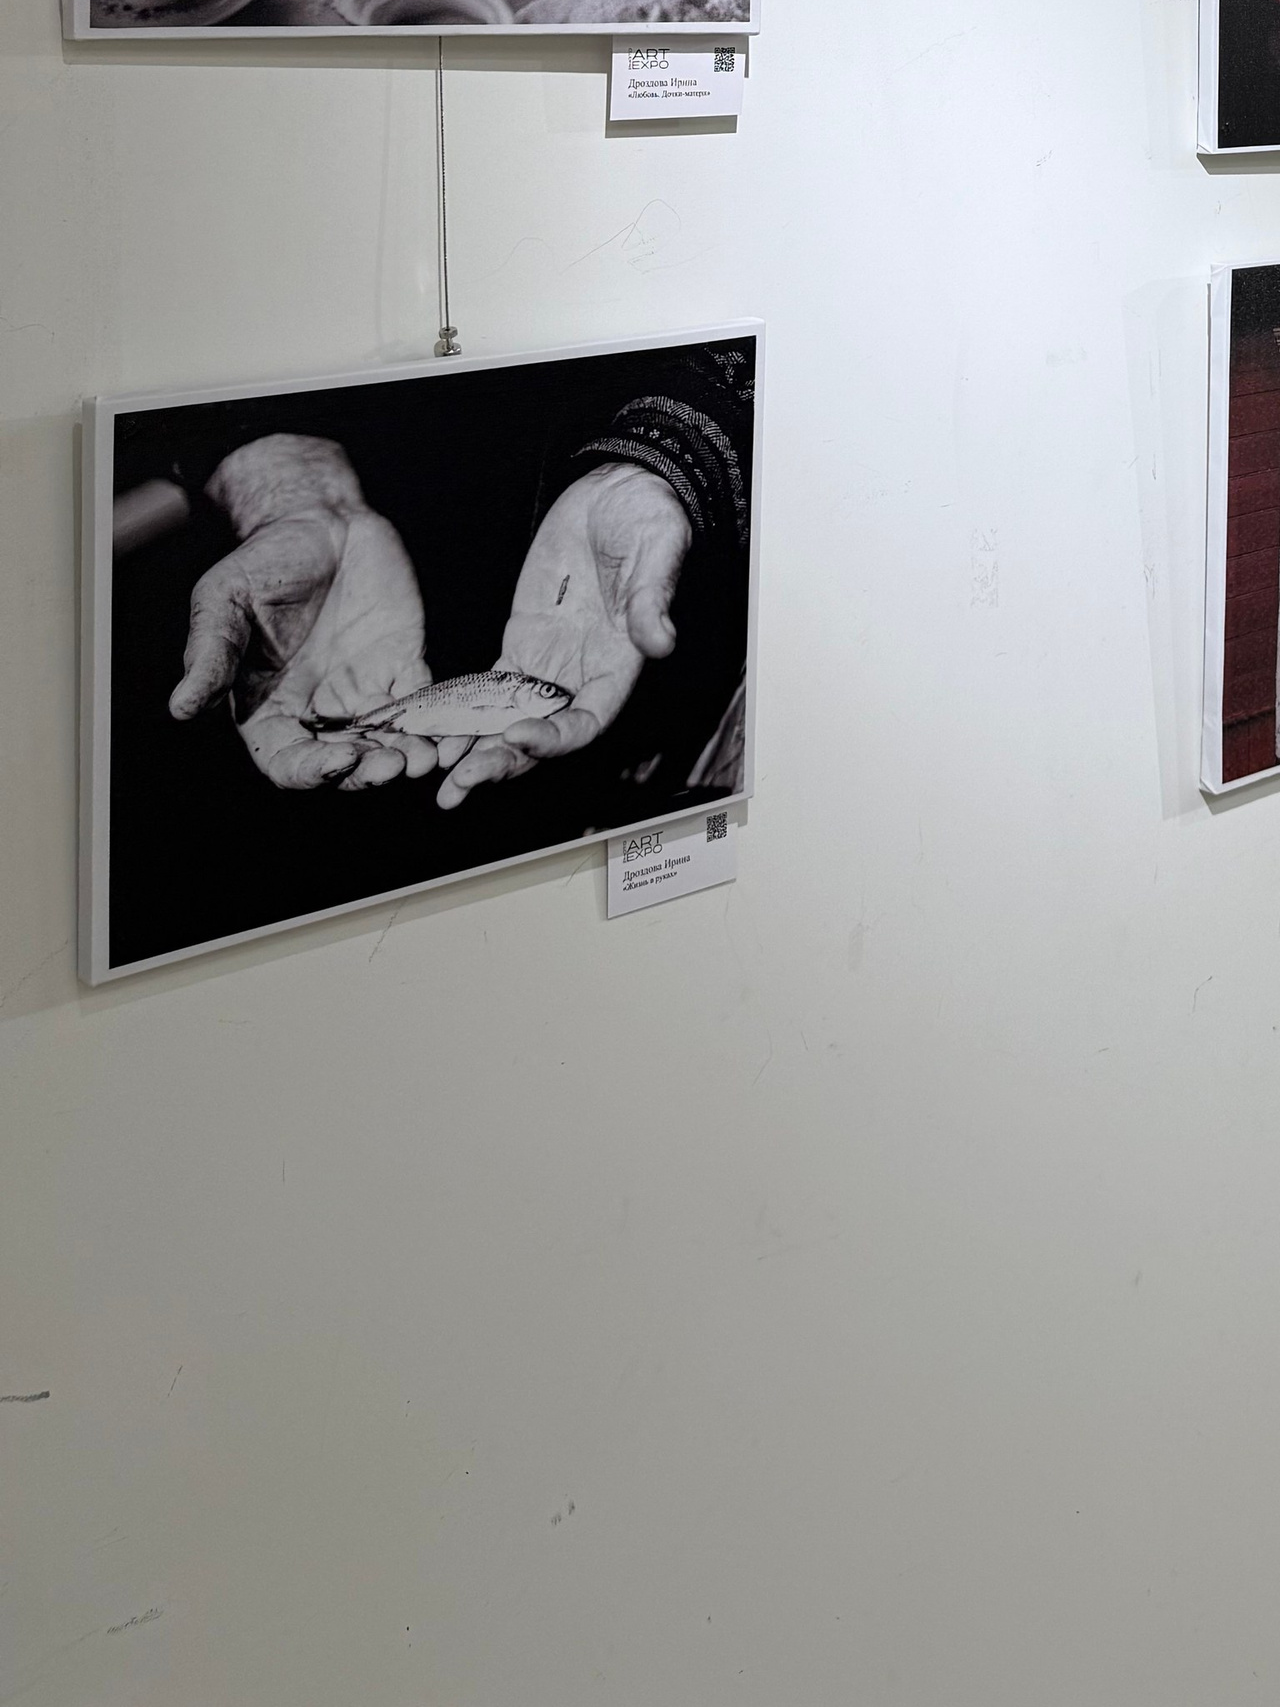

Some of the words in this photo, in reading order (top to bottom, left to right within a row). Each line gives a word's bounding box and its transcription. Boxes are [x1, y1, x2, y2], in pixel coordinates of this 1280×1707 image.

[632, 48, 670, 60] ART
[632, 60, 669, 70] EXPO
[627, 831, 664, 853] ART
[627, 844, 663, 862] EXPO
